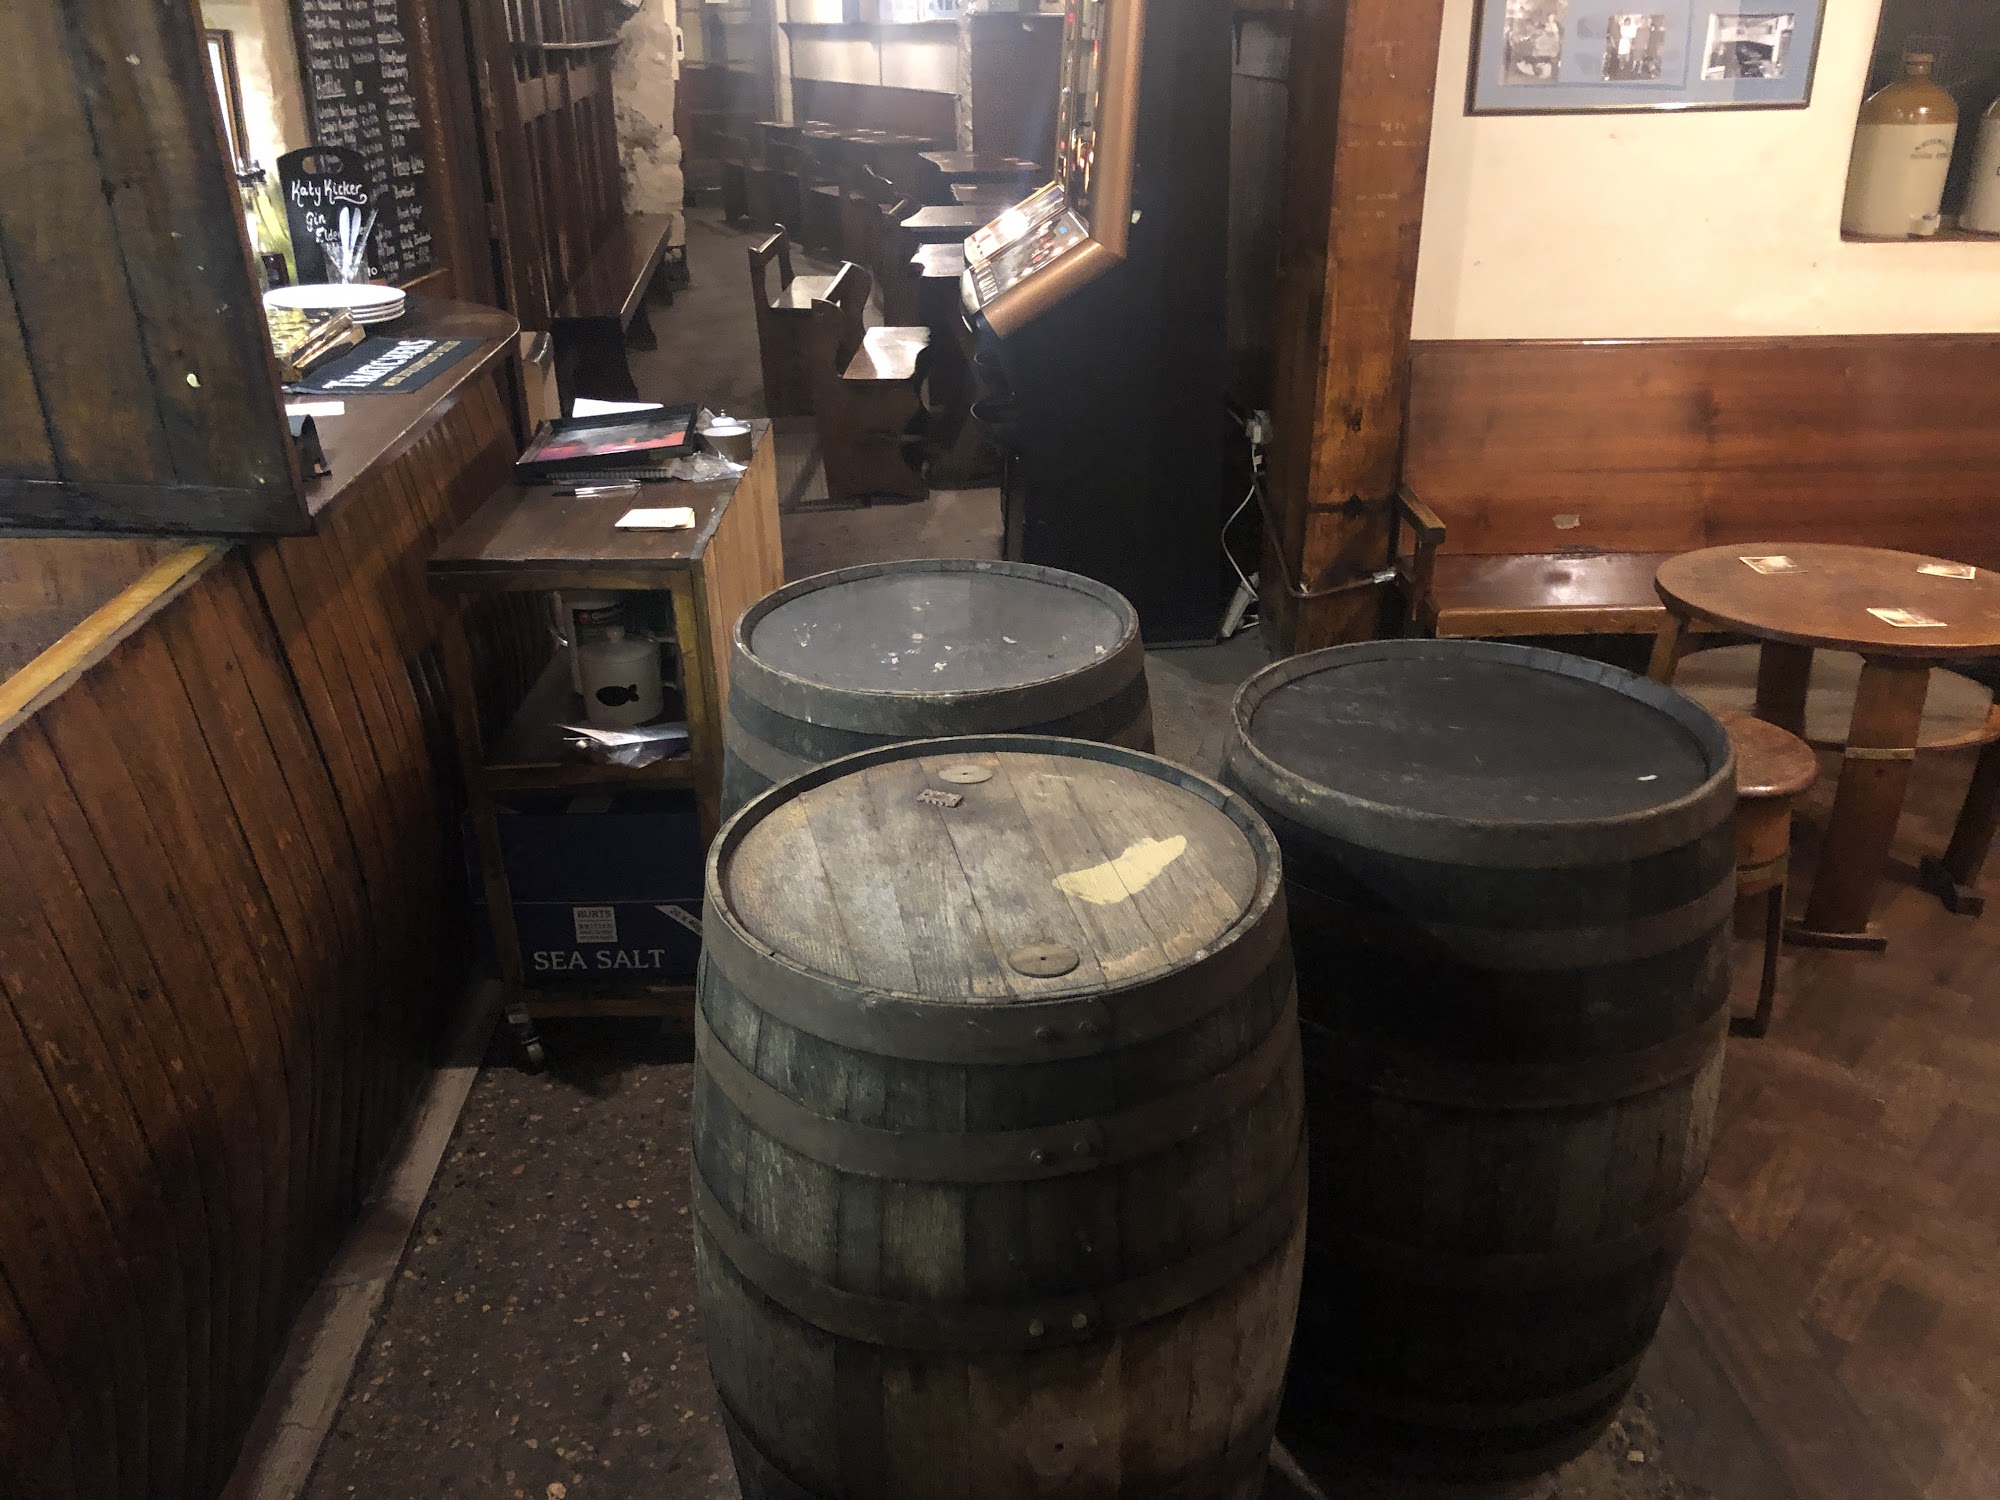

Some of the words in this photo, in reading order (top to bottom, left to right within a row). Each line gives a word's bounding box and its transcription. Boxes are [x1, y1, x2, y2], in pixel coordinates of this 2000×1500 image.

[291, 179, 321, 207] Katy
[323, 179, 363, 204] Kicker
[305, 212, 326, 232] Gin
[577, 909, 612, 918] BURTS
[533, 951, 588, 970] SEA
[596, 949, 665, 969] SALT
